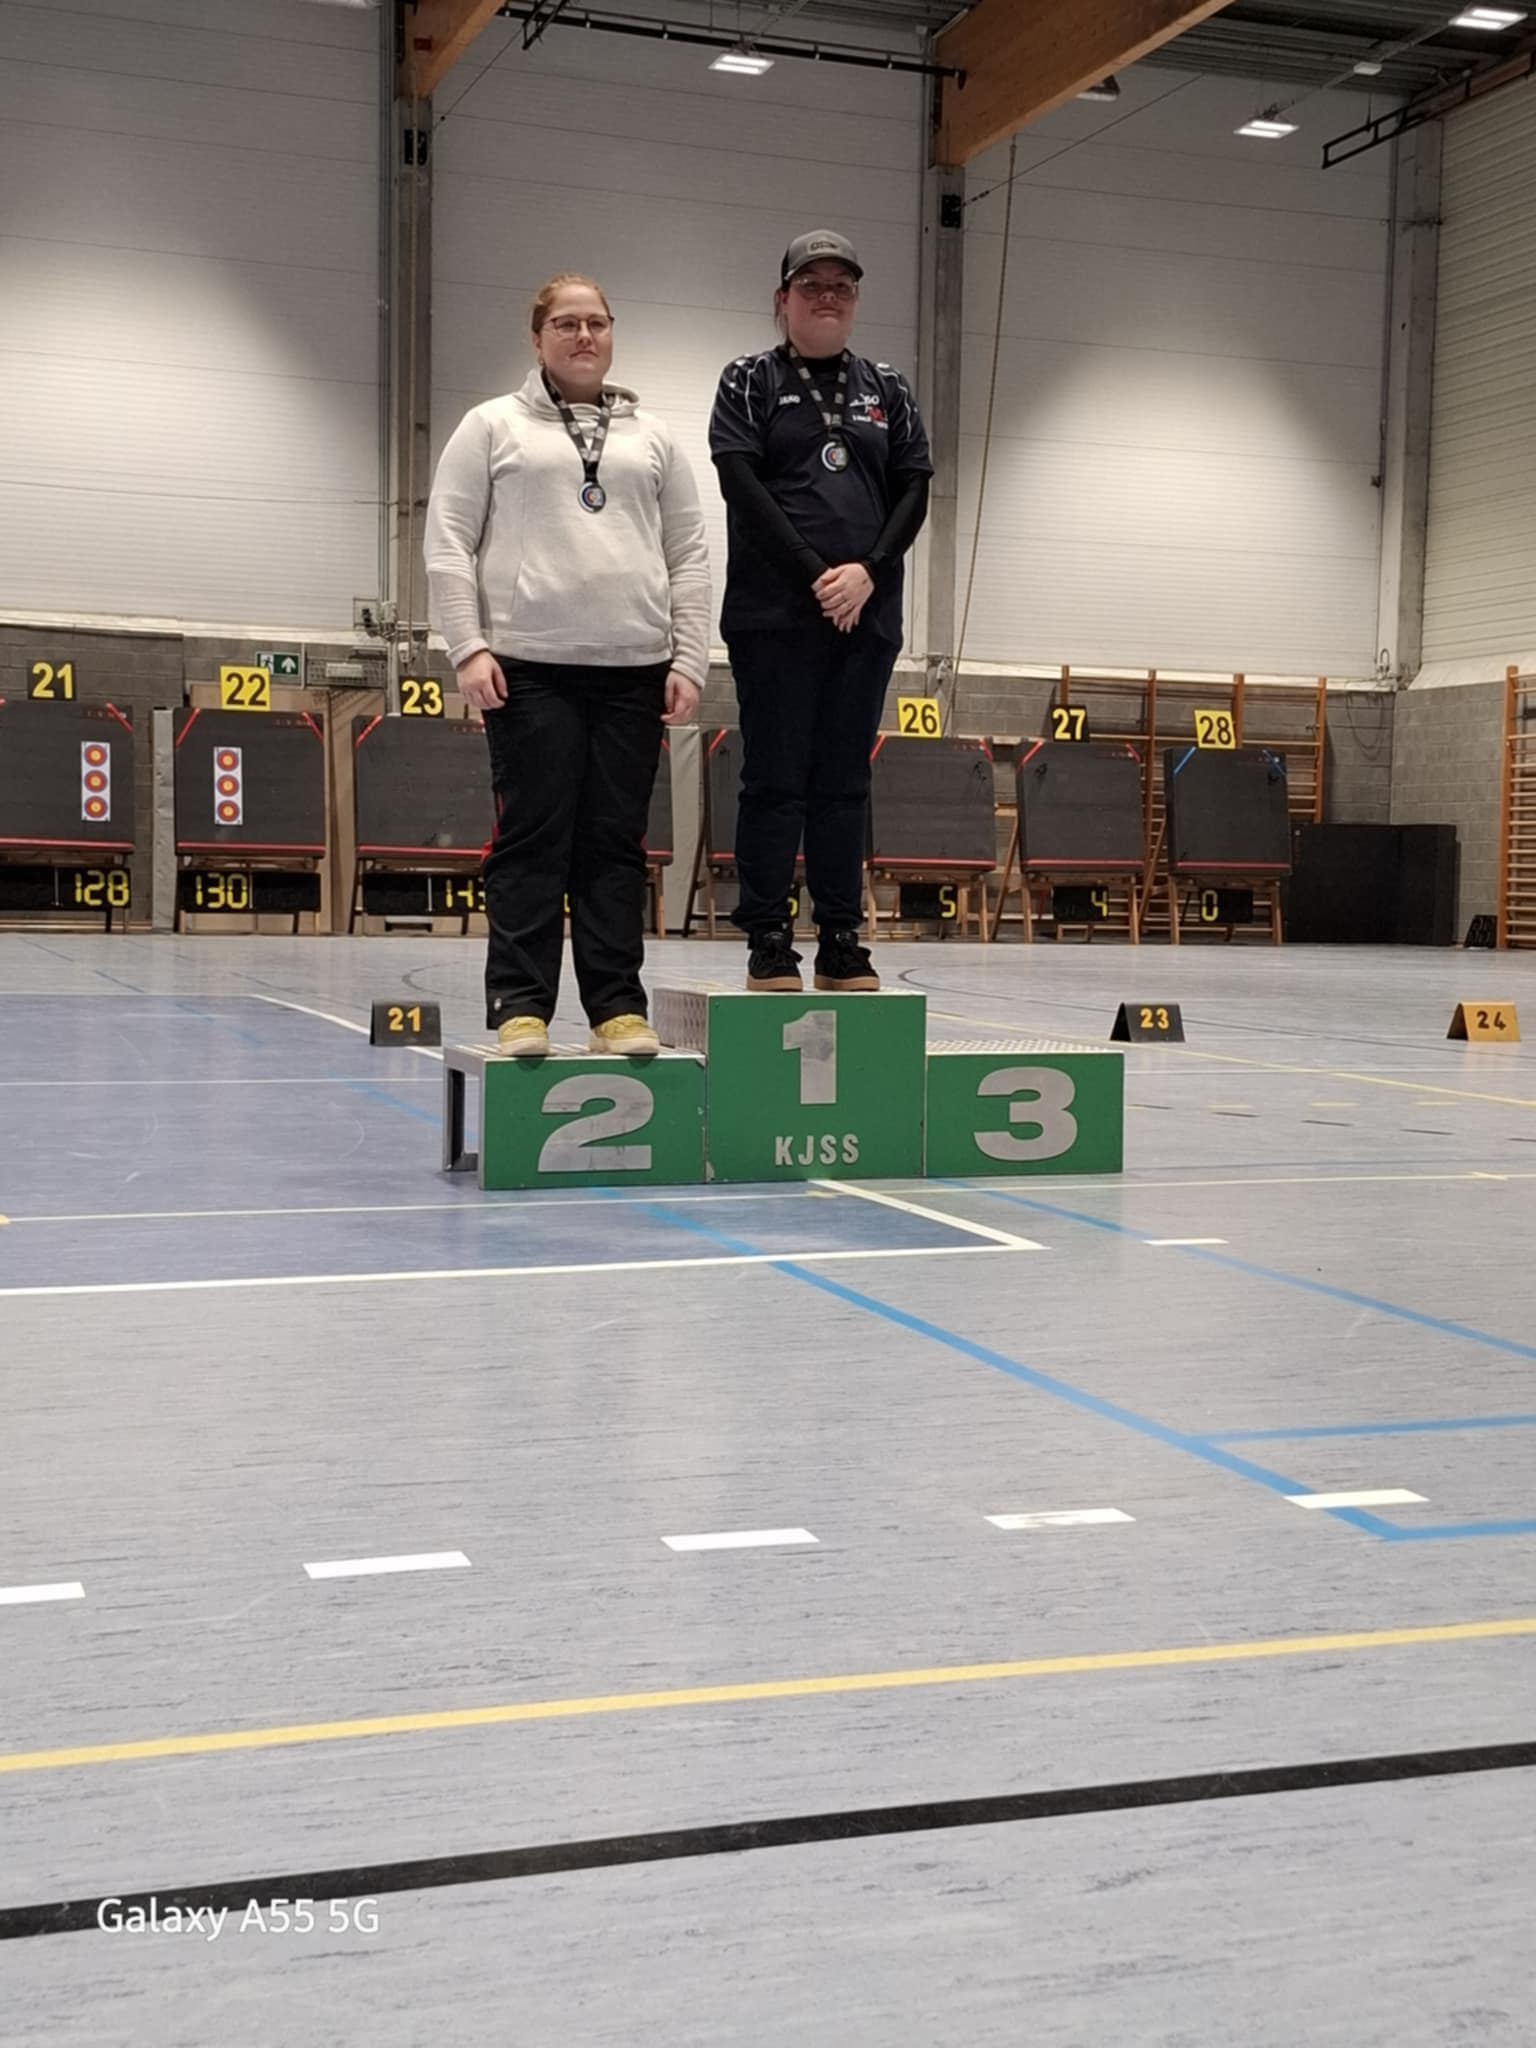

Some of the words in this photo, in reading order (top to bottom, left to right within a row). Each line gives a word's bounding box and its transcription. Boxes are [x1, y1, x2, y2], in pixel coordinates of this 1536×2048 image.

[32, 661, 73, 700] 21
[225, 671, 268, 706] 22
[401, 679, 443, 714] 23
[903, 703, 937, 735] 26
[1053, 707, 1087, 740] 27
[1199, 714, 1233, 746] 28
[75, 869, 130, 907] 128
[195, 872, 249, 910] 130
[939, 885, 957, 919] 5
[1091, 888, 1108, 918] 4
[1201, 888, 1219, 922] 0
[388, 1006, 422, 1033] 21
[1139, 1007, 1170, 1030] 23
[1476, 1010, 1507, 1031] 24
[782, 1009, 837, 1105] 1
[538, 1074, 655, 1173] 2
[974, 1066, 1078, 1162] 3
[774, 1133, 860, 1166] KJSS
